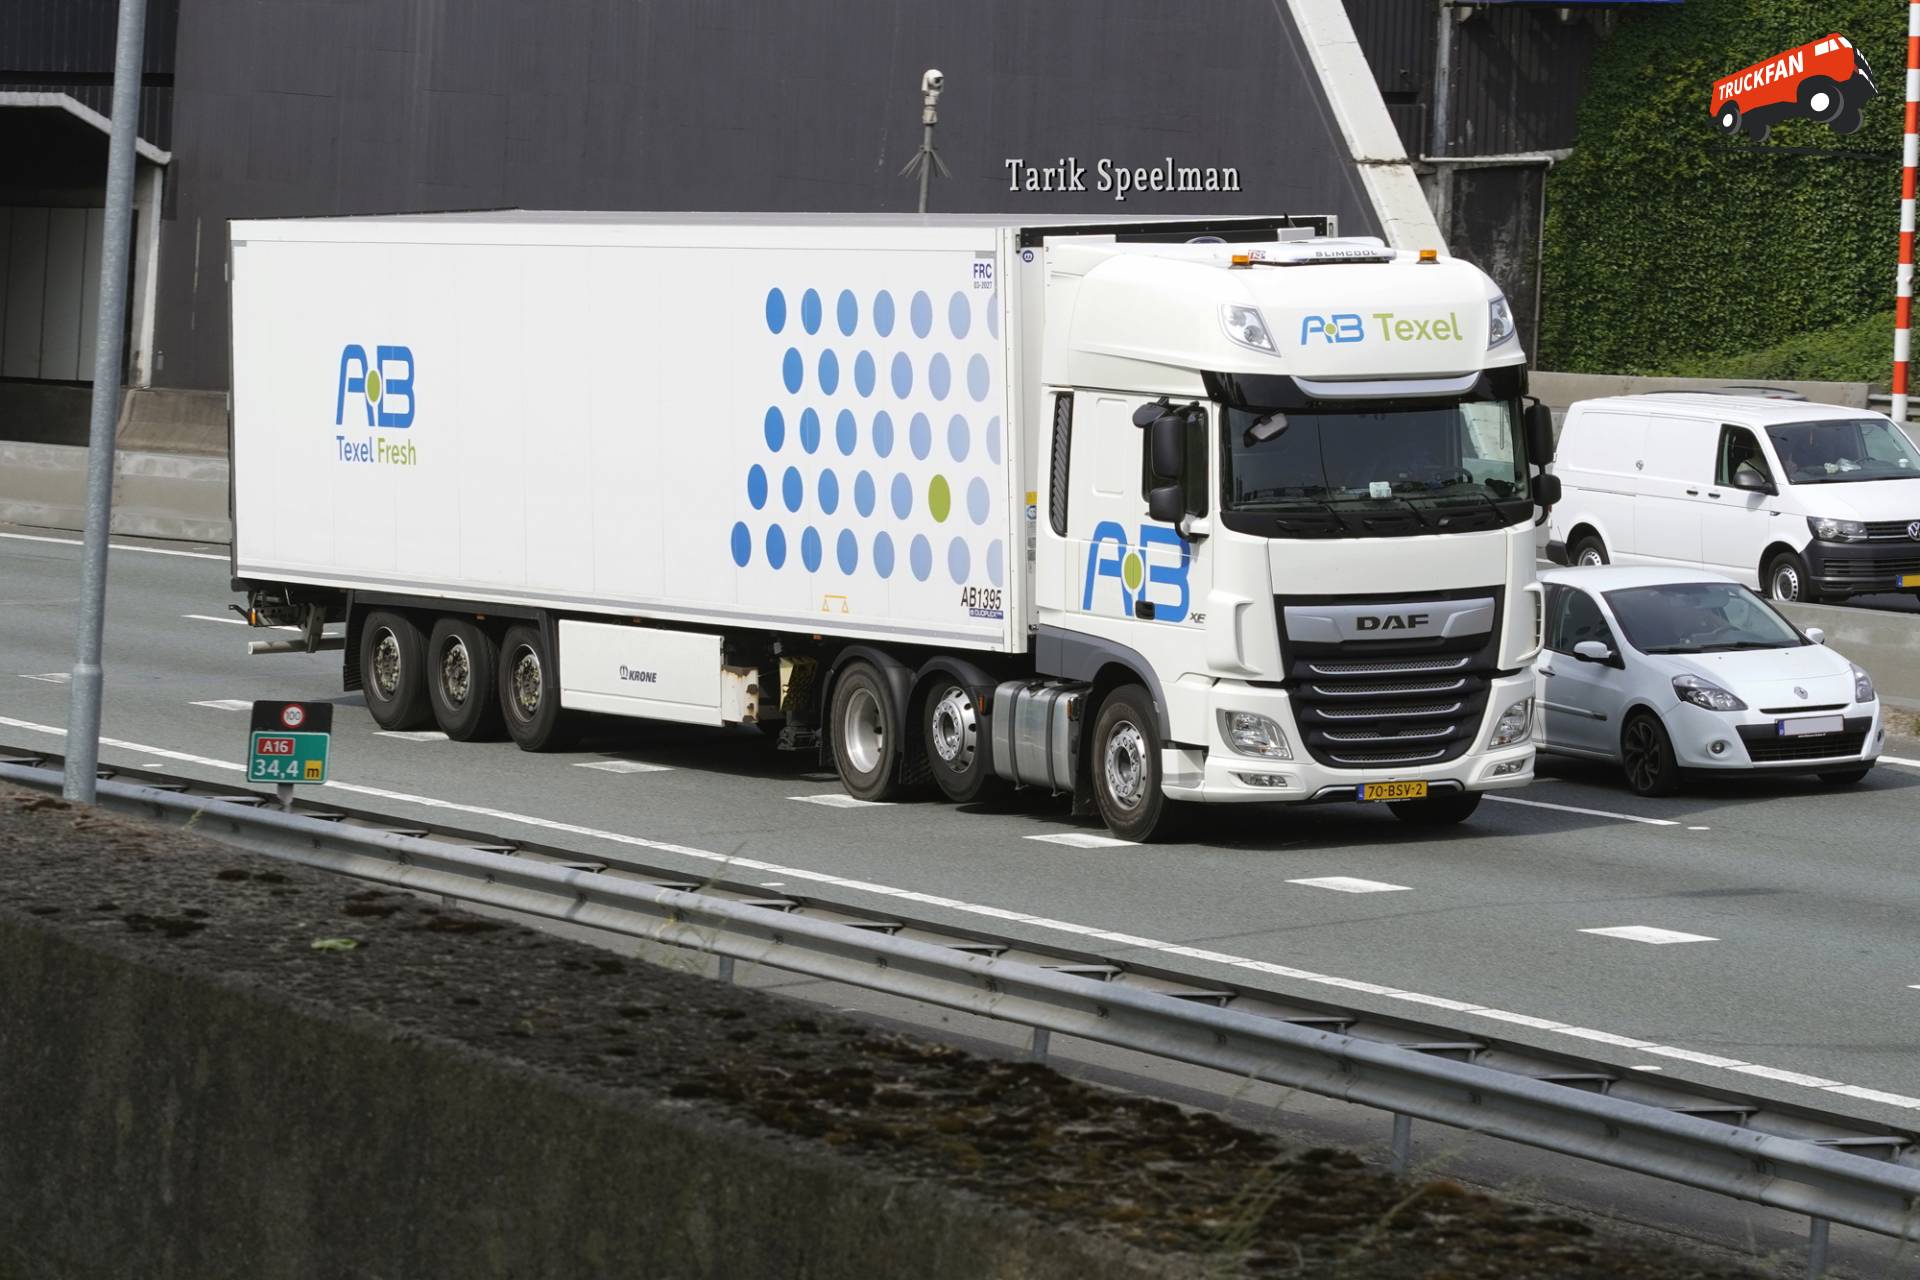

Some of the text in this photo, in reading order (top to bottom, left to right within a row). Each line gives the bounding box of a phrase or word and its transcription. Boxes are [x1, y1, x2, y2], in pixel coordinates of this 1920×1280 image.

[1315, 250, 1378, 258] SLIMCOOL
[973, 263, 992, 279] FRC
[1301, 312, 1463, 345] AB Texel
[336, 344, 415, 428] AB
[336, 435, 416, 466] Texel Fresh
[1082, 520, 1190, 623] AB
[960, 586, 1002, 610] AB1395
[1356, 614, 1429, 631] DAF
[629, 669, 657, 683] KRONE
[286, 711, 301, 721] 100
[263, 740, 288, 753] A16
[254, 759, 319, 778] 34,4 m
[1368, 783, 1423, 798] 70-BSV-2
